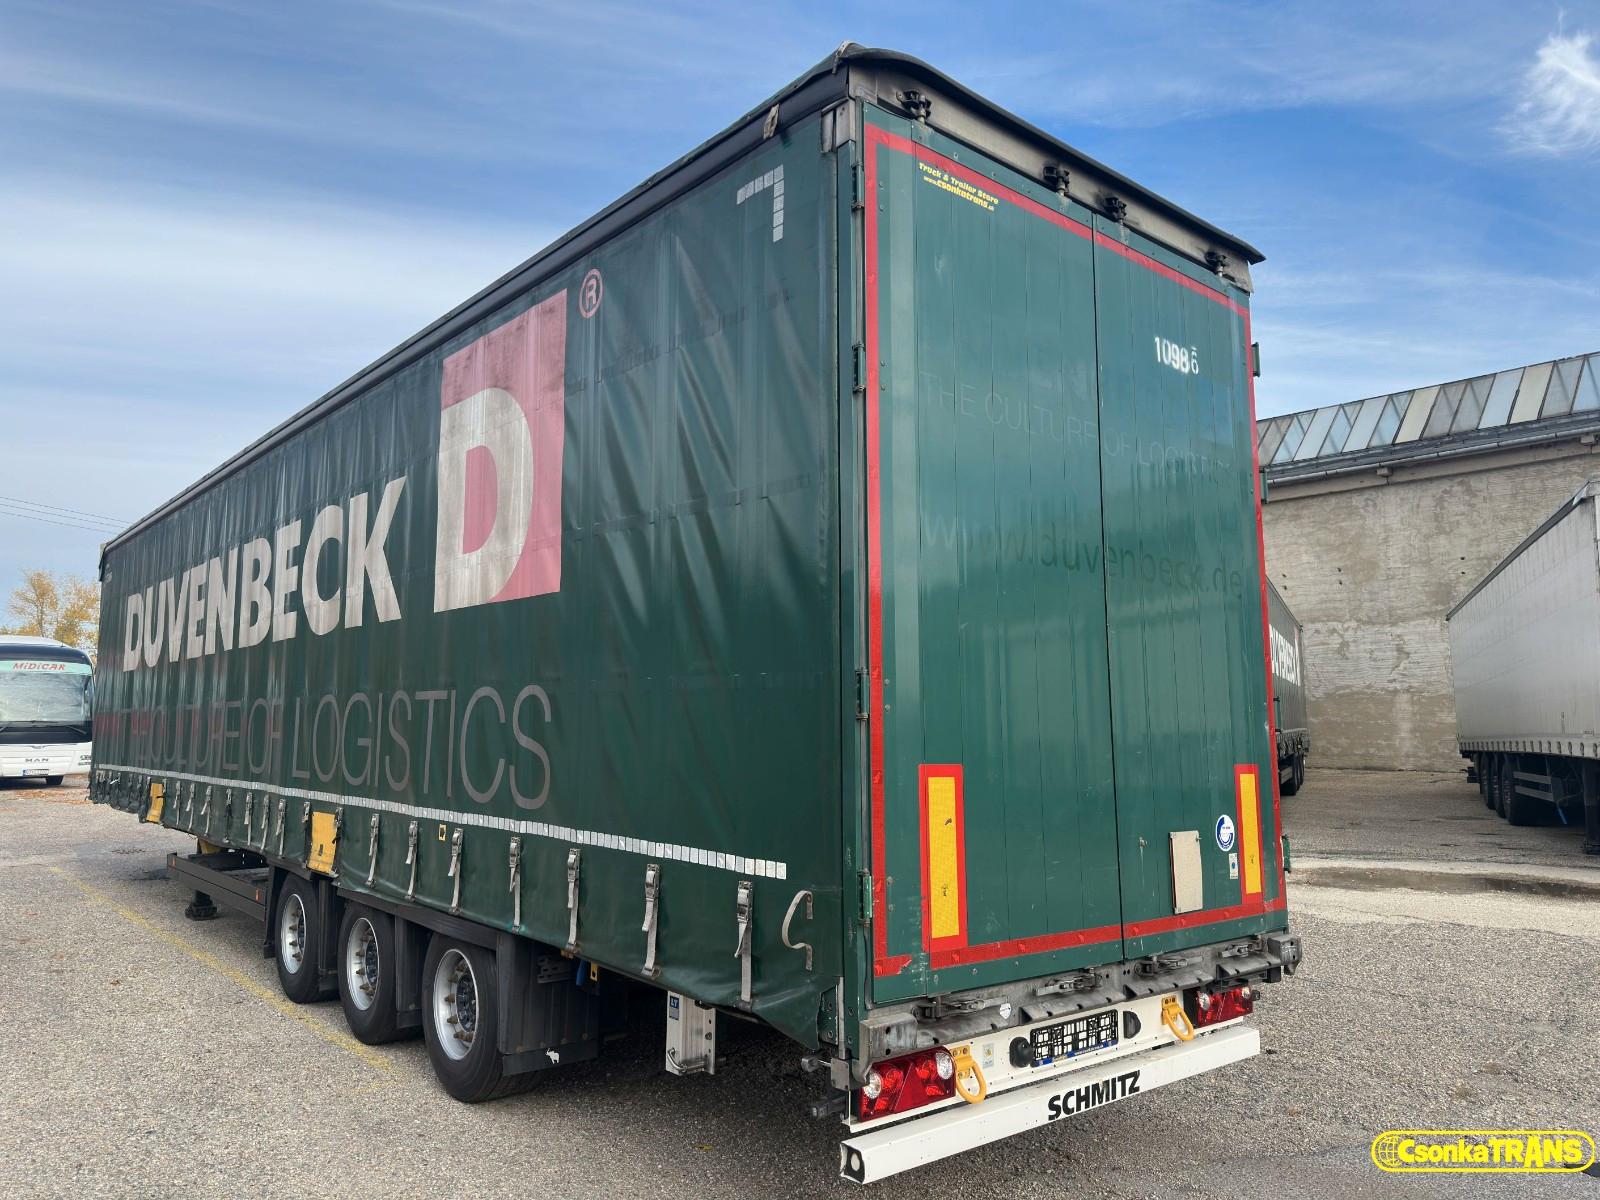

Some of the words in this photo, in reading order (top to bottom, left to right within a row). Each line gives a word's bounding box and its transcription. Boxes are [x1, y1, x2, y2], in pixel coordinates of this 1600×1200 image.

[919, 162, 941, 178] Truck
[951, 178, 976, 193] Trailer
[978, 190, 999, 204] Store
[122, 474, 408, 673] DUVENBECK
[292, 684, 552, 810] LOGISTICS
[1048, 1069, 1140, 1121] SCHMITZ
